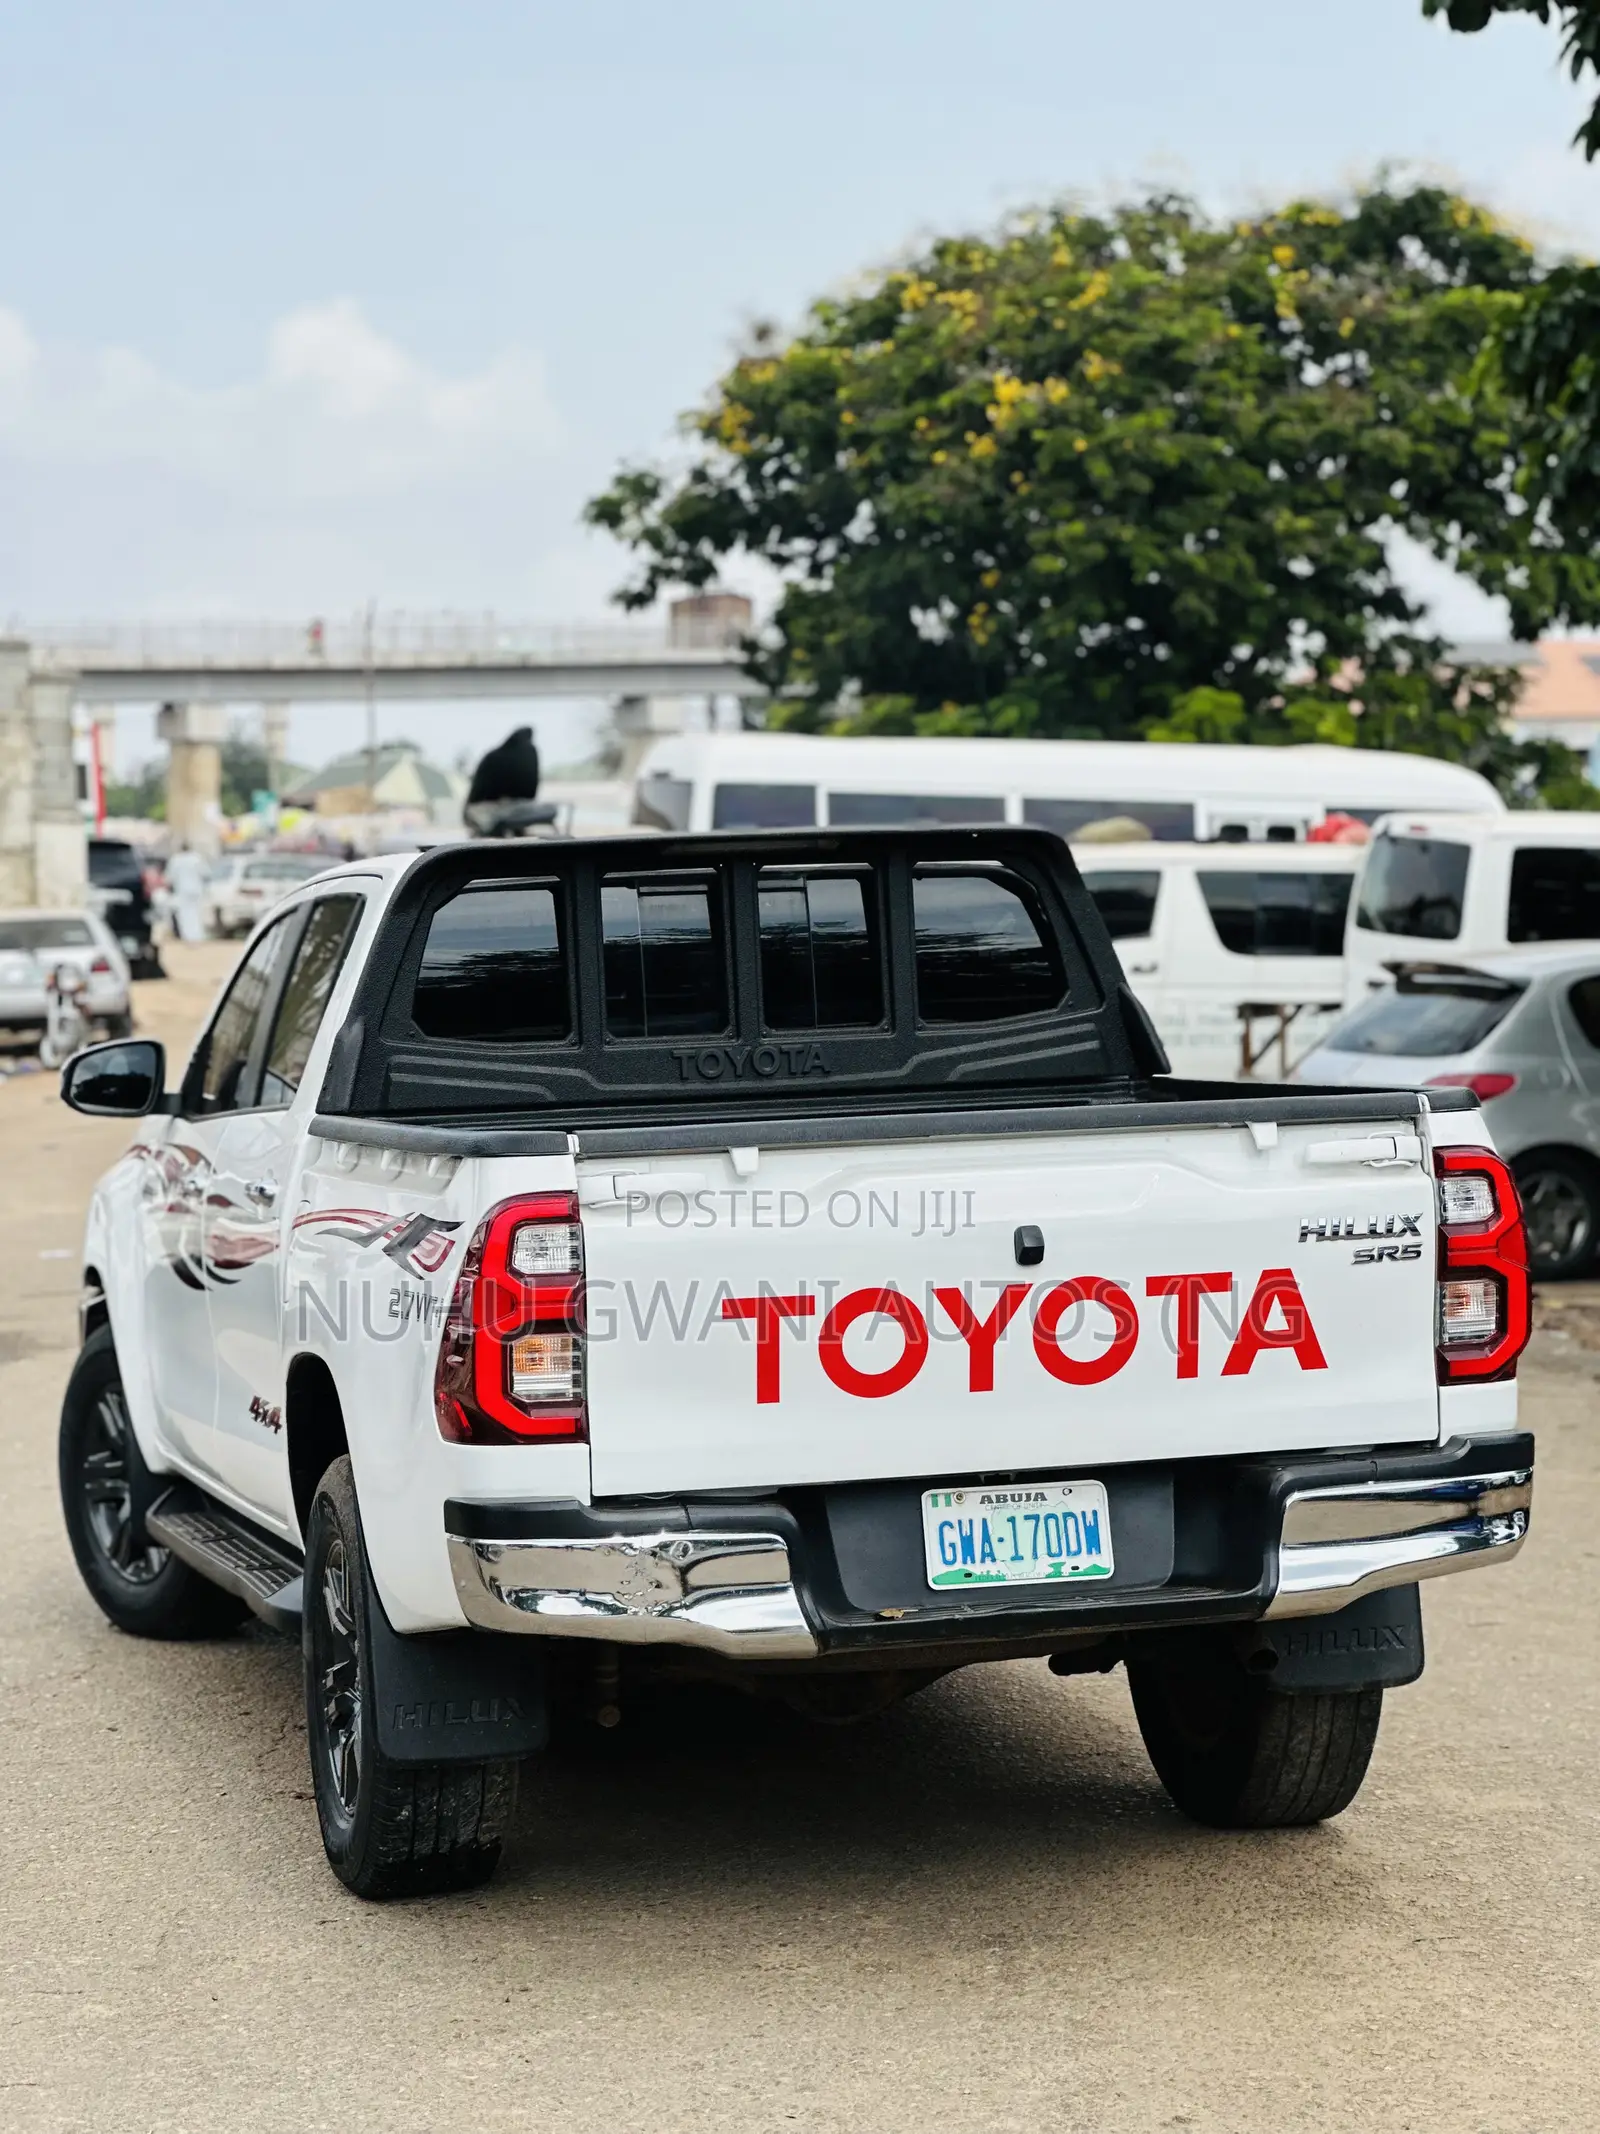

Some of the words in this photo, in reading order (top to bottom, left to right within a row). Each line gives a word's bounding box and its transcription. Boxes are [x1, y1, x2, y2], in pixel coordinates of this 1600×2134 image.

[673, 1045, 831, 1080] TOYOTA
[1298, 1212, 1423, 1242] HILUX
[1351, 1242, 1423, 1265] SR5
[722, 1268, 1328, 1405] TOYOTA
[979, 1491, 1047, 1505] ABUJA
[1284, 1624, 1406, 1657] HILUX
[393, 1698, 528, 1732] HILUX
